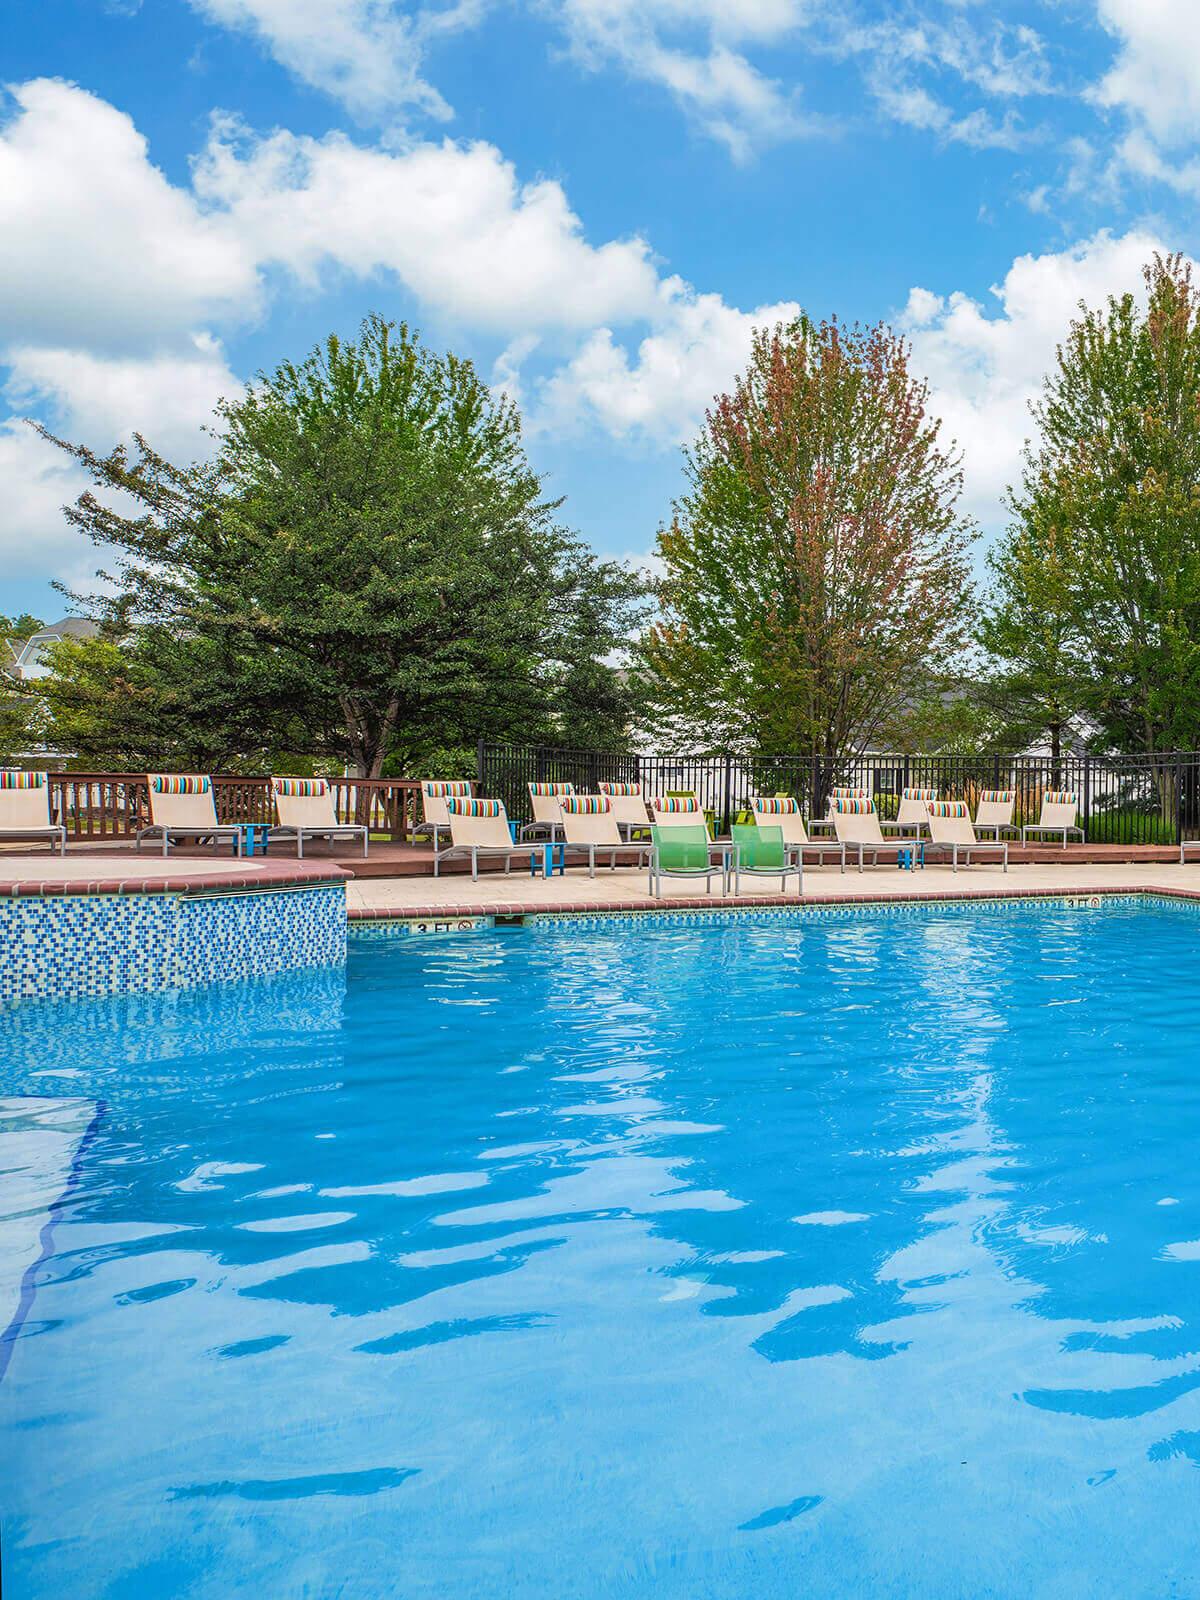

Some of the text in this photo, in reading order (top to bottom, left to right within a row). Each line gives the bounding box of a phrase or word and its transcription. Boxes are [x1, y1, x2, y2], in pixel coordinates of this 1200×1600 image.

[1068, 899, 1074, 908] 3
[417, 922, 452, 933] 3 FT
